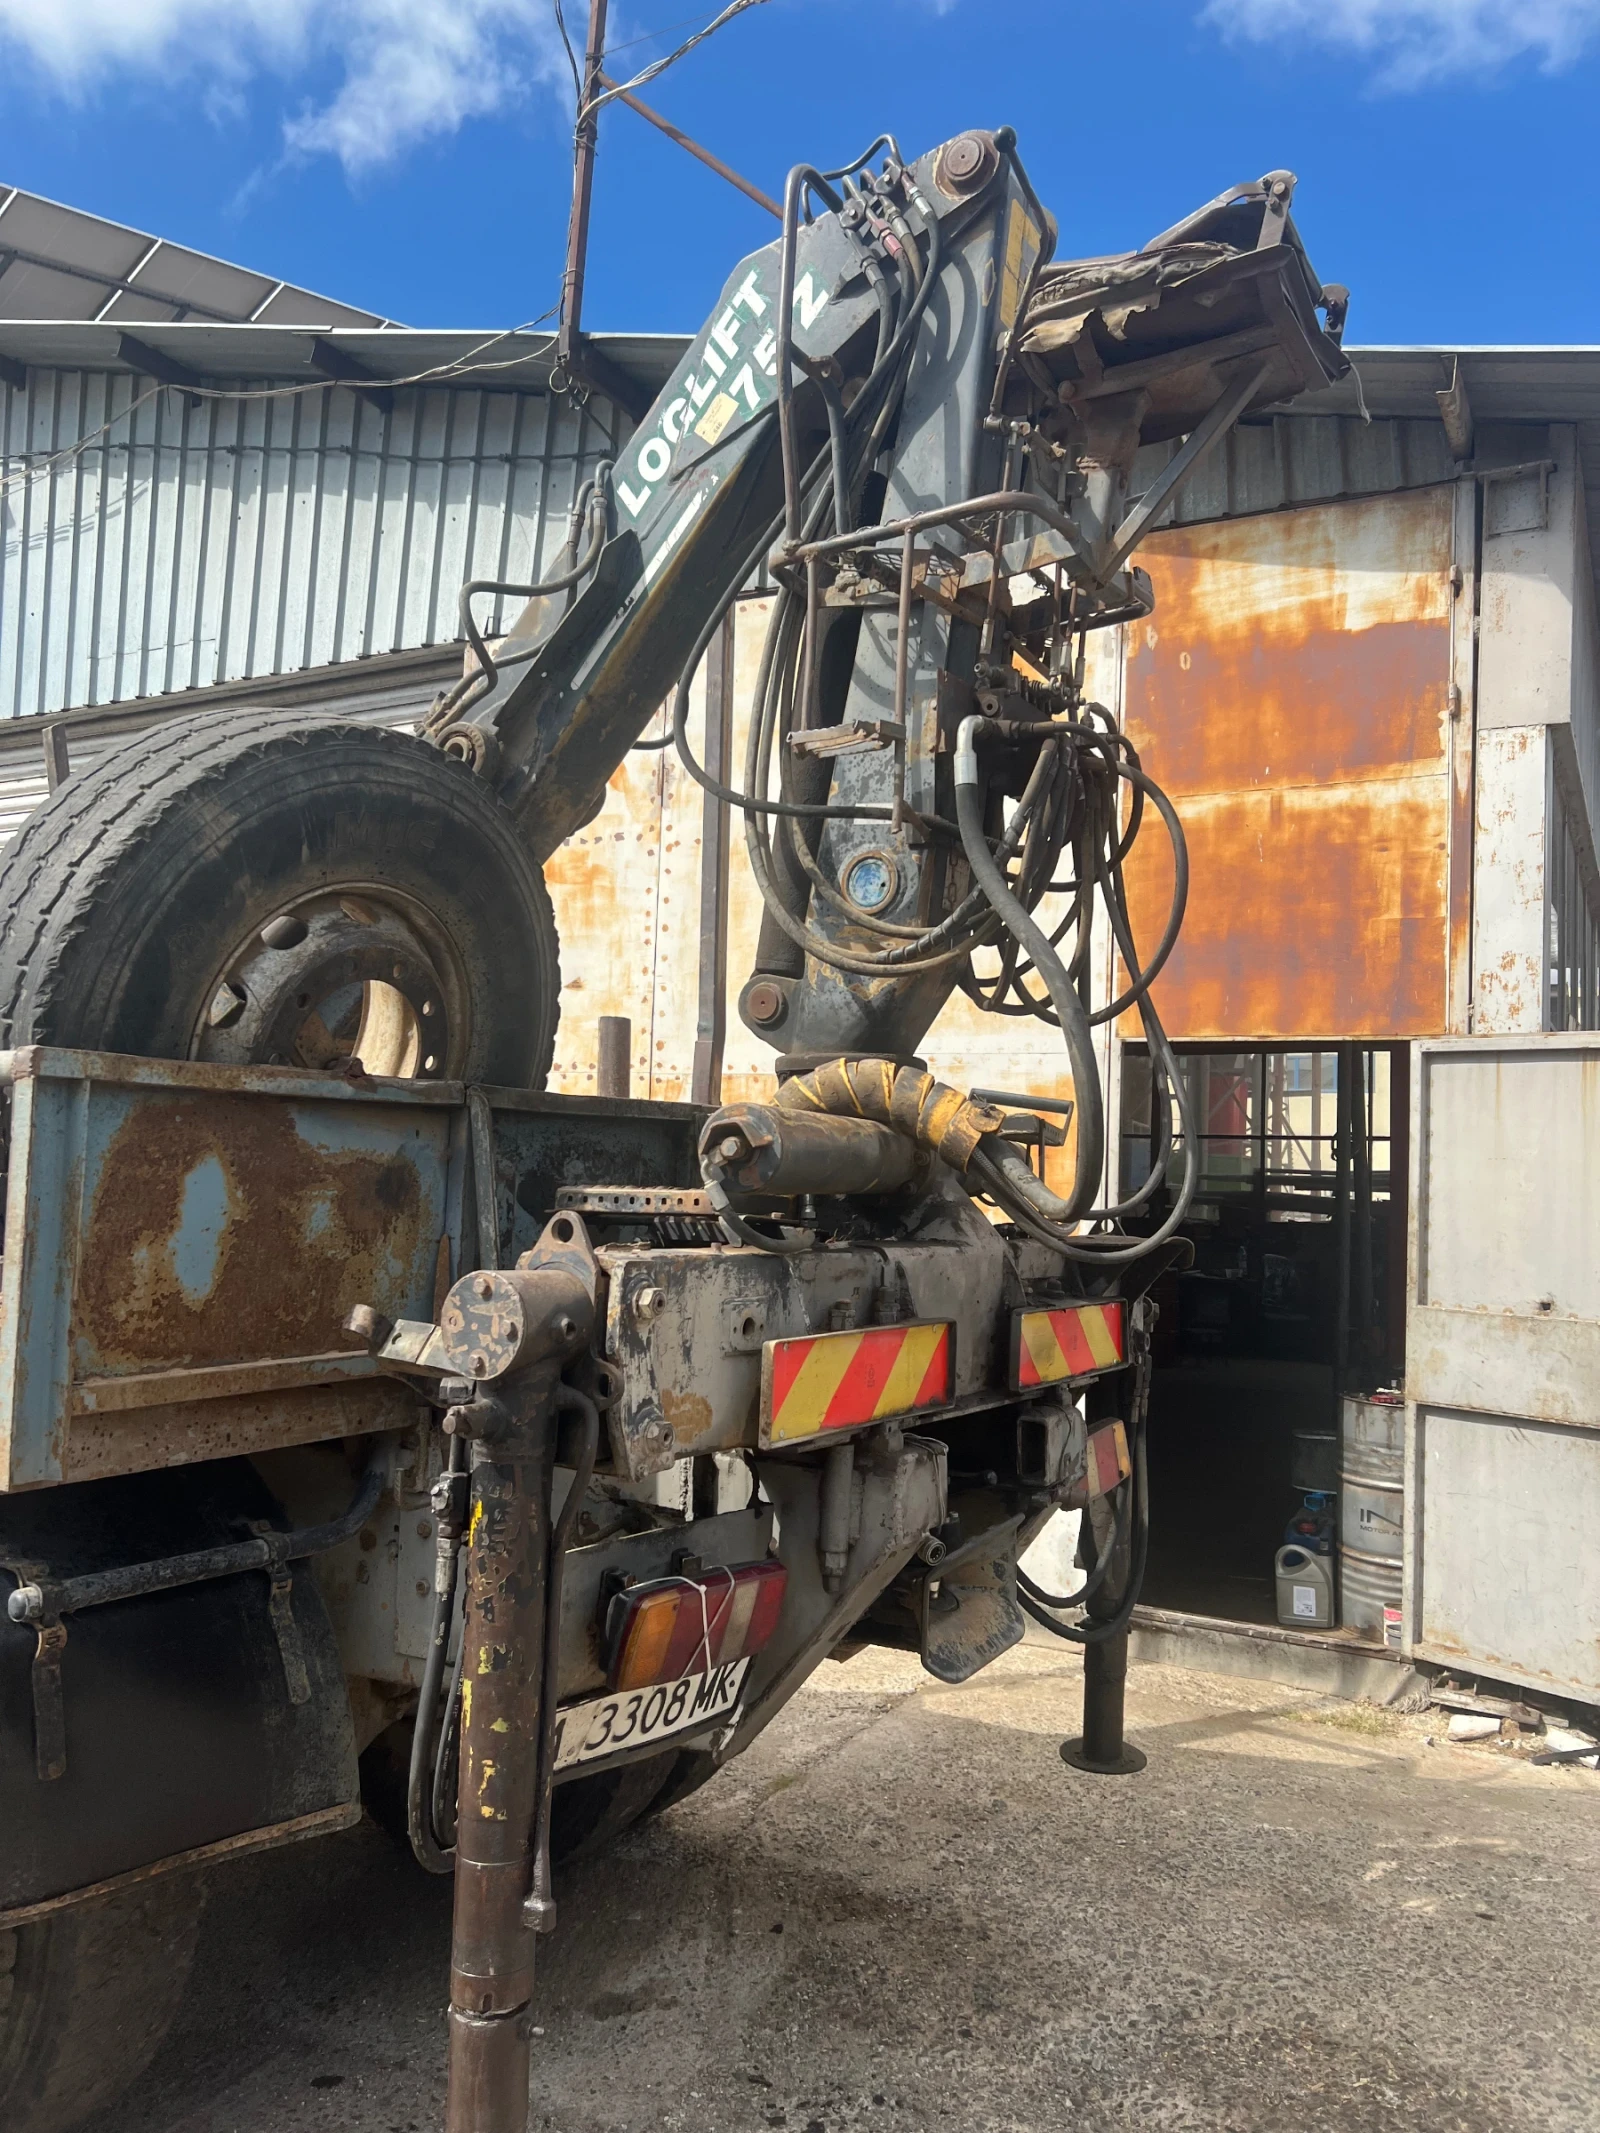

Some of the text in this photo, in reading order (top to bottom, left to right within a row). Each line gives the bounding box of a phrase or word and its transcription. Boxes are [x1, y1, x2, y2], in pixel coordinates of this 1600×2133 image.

[617, 269, 767, 518] LOGLIFT
[1360, 1524, 1390, 1535] MOTOR
[584, 1678, 691, 1751] 3308
[687, 1660, 738, 1720] MK
